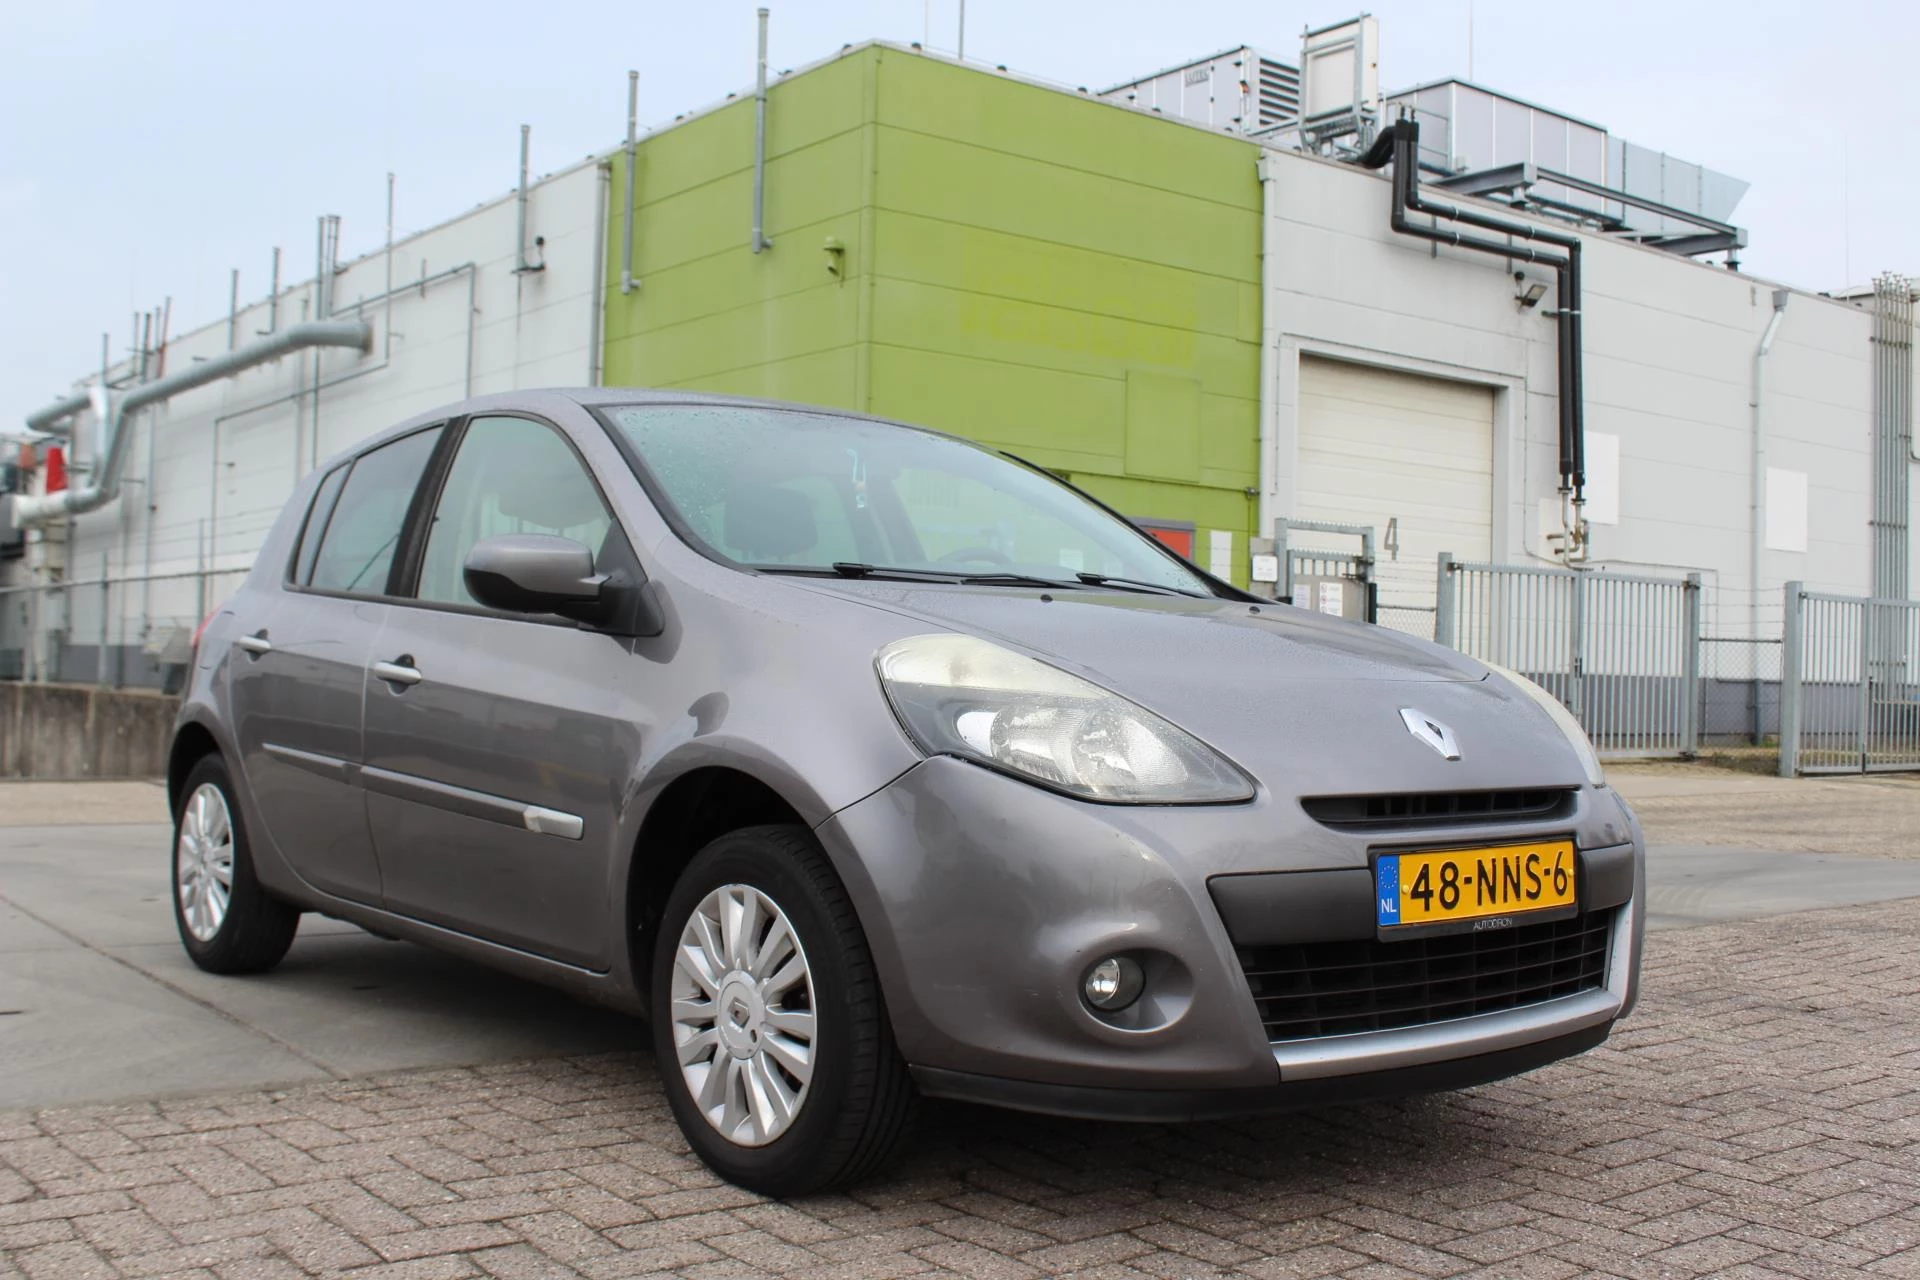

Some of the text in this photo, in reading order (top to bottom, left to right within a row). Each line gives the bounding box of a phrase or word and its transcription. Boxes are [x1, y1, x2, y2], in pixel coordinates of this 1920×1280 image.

[1383, 517, 1399, 561] 4
[1410, 851, 1568, 912] 48-NNS-6
[1381, 897, 1397, 913] NL
